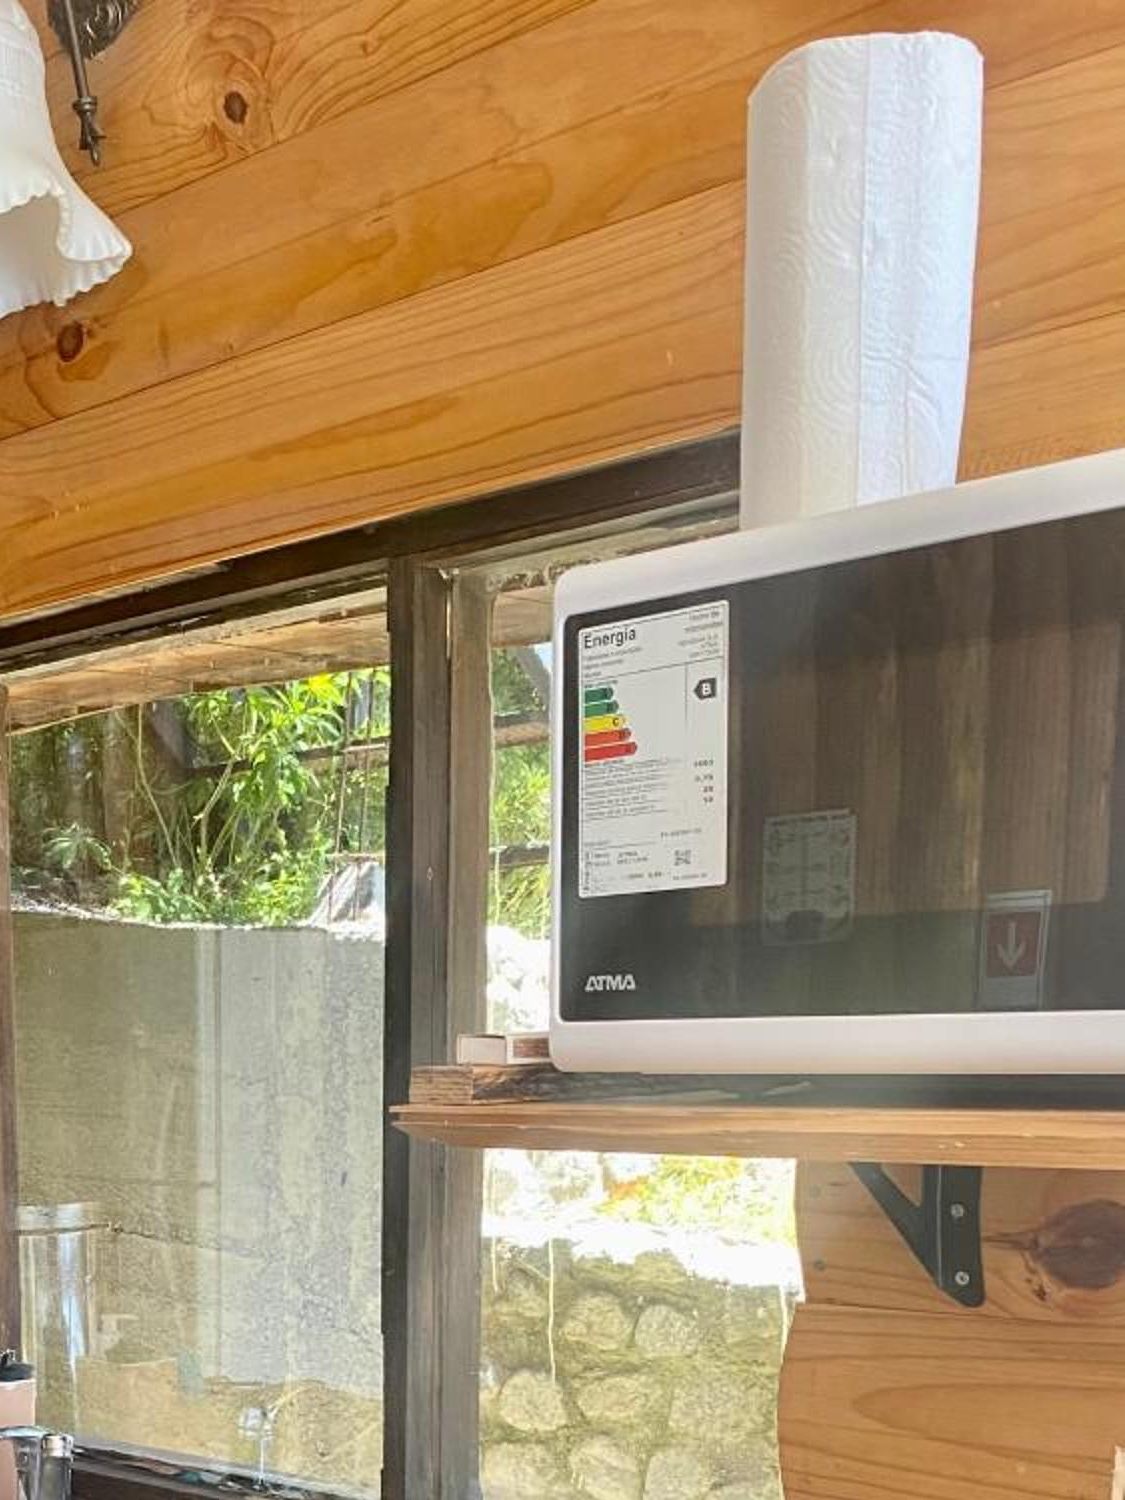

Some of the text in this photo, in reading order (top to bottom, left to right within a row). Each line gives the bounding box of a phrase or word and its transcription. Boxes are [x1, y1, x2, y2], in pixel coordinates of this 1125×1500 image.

[584, 626, 636, 649] Energia
[702, 683, 712, 696] B
[585, 974, 636, 992] ATMA
